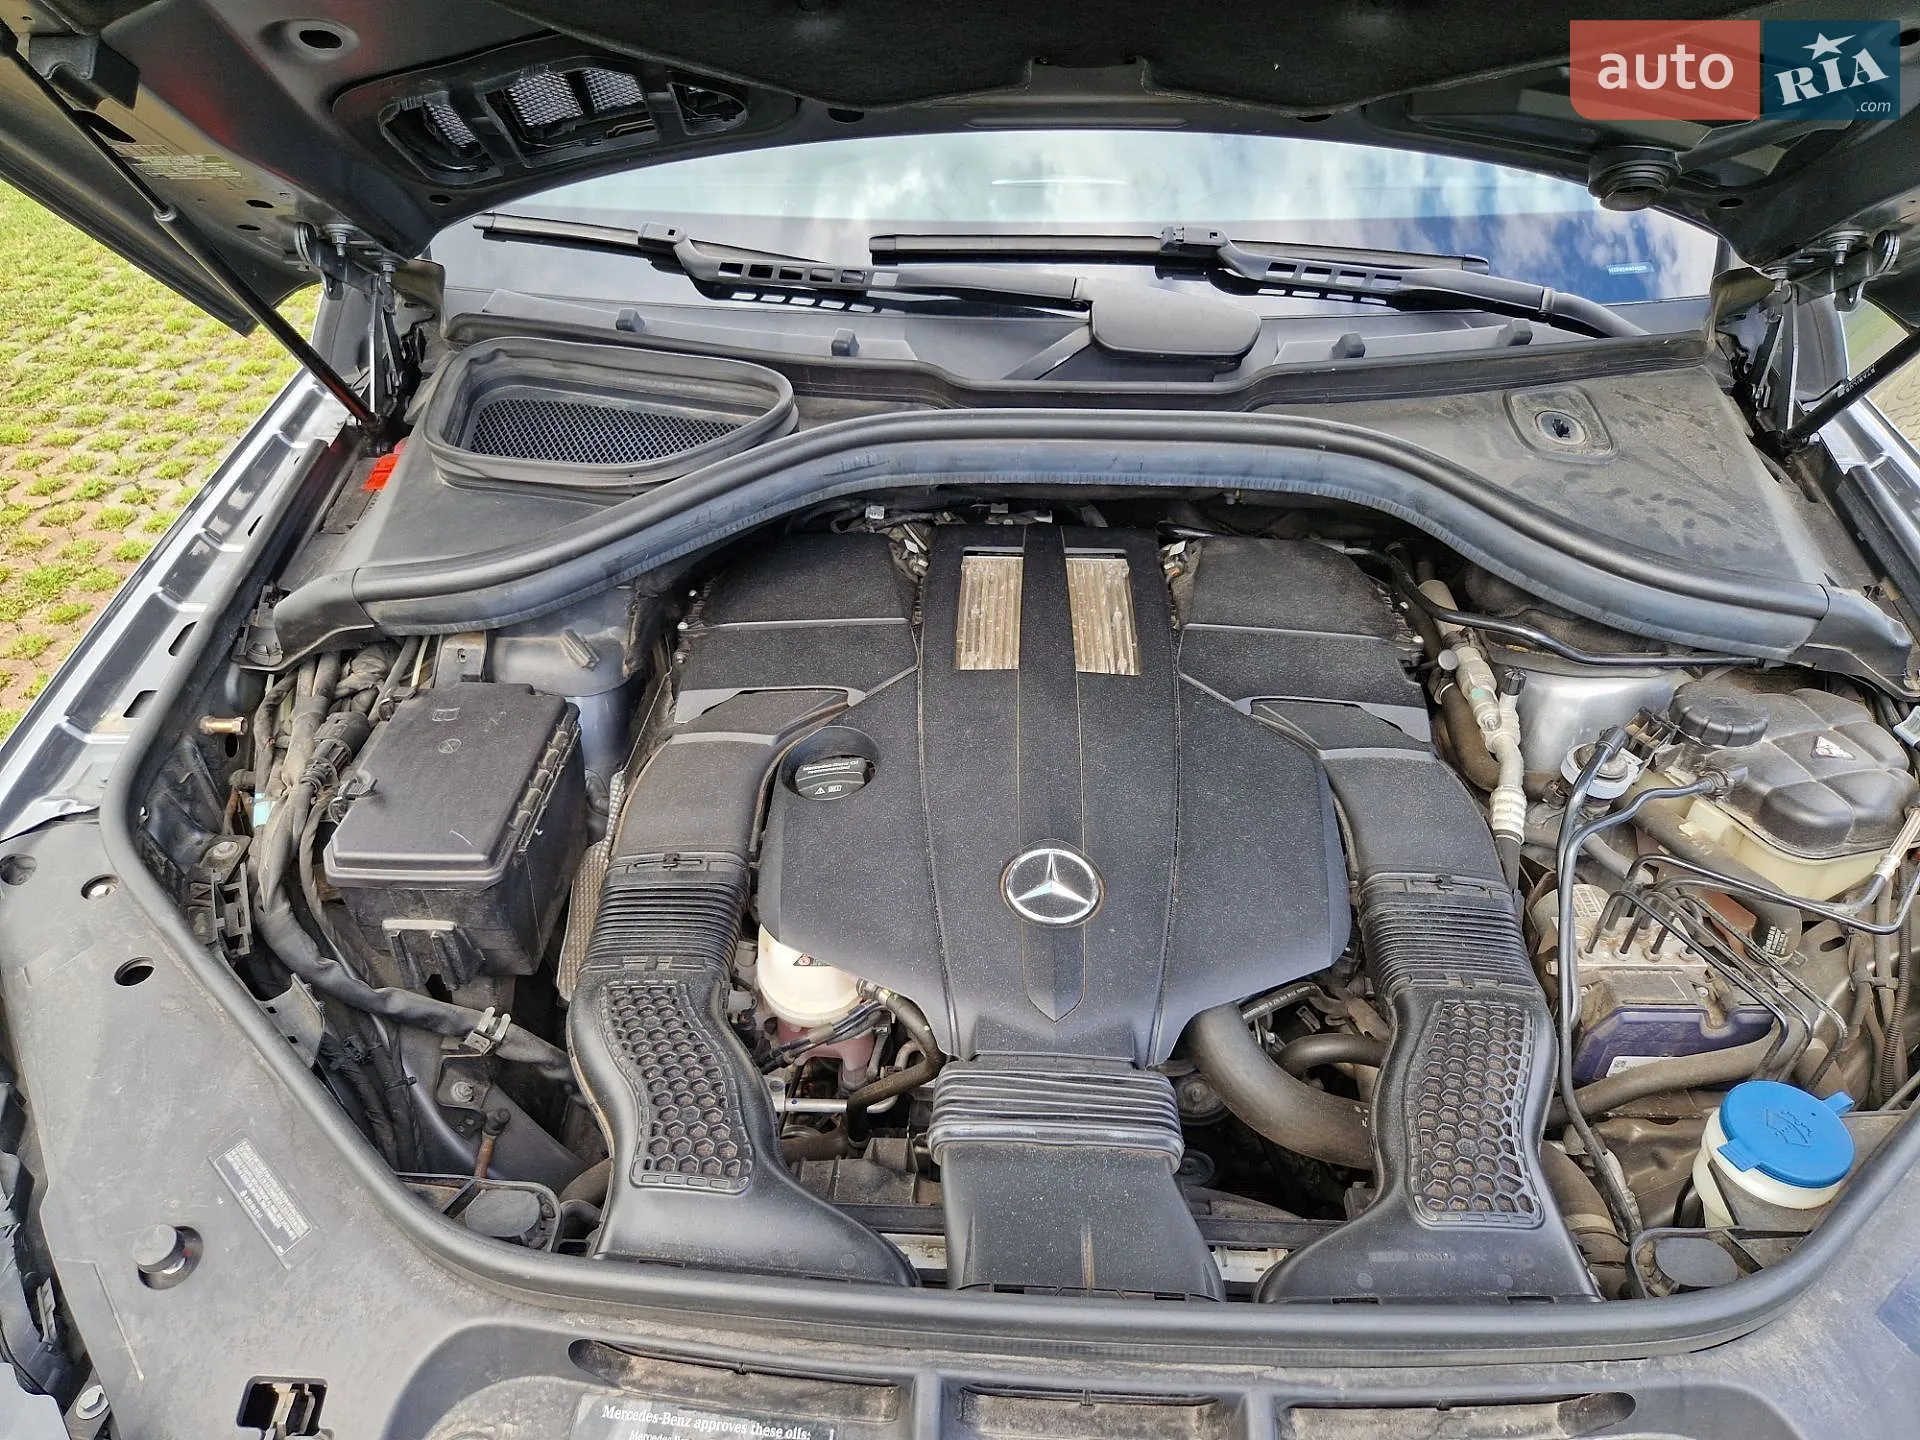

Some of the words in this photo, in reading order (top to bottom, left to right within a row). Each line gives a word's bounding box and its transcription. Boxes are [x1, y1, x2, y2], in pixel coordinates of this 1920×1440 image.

[601, 1405, 693, 1428] Mercedes-Benz
[694, 1417, 748, 1433] approves
[751, 1422, 783, 1438] these
